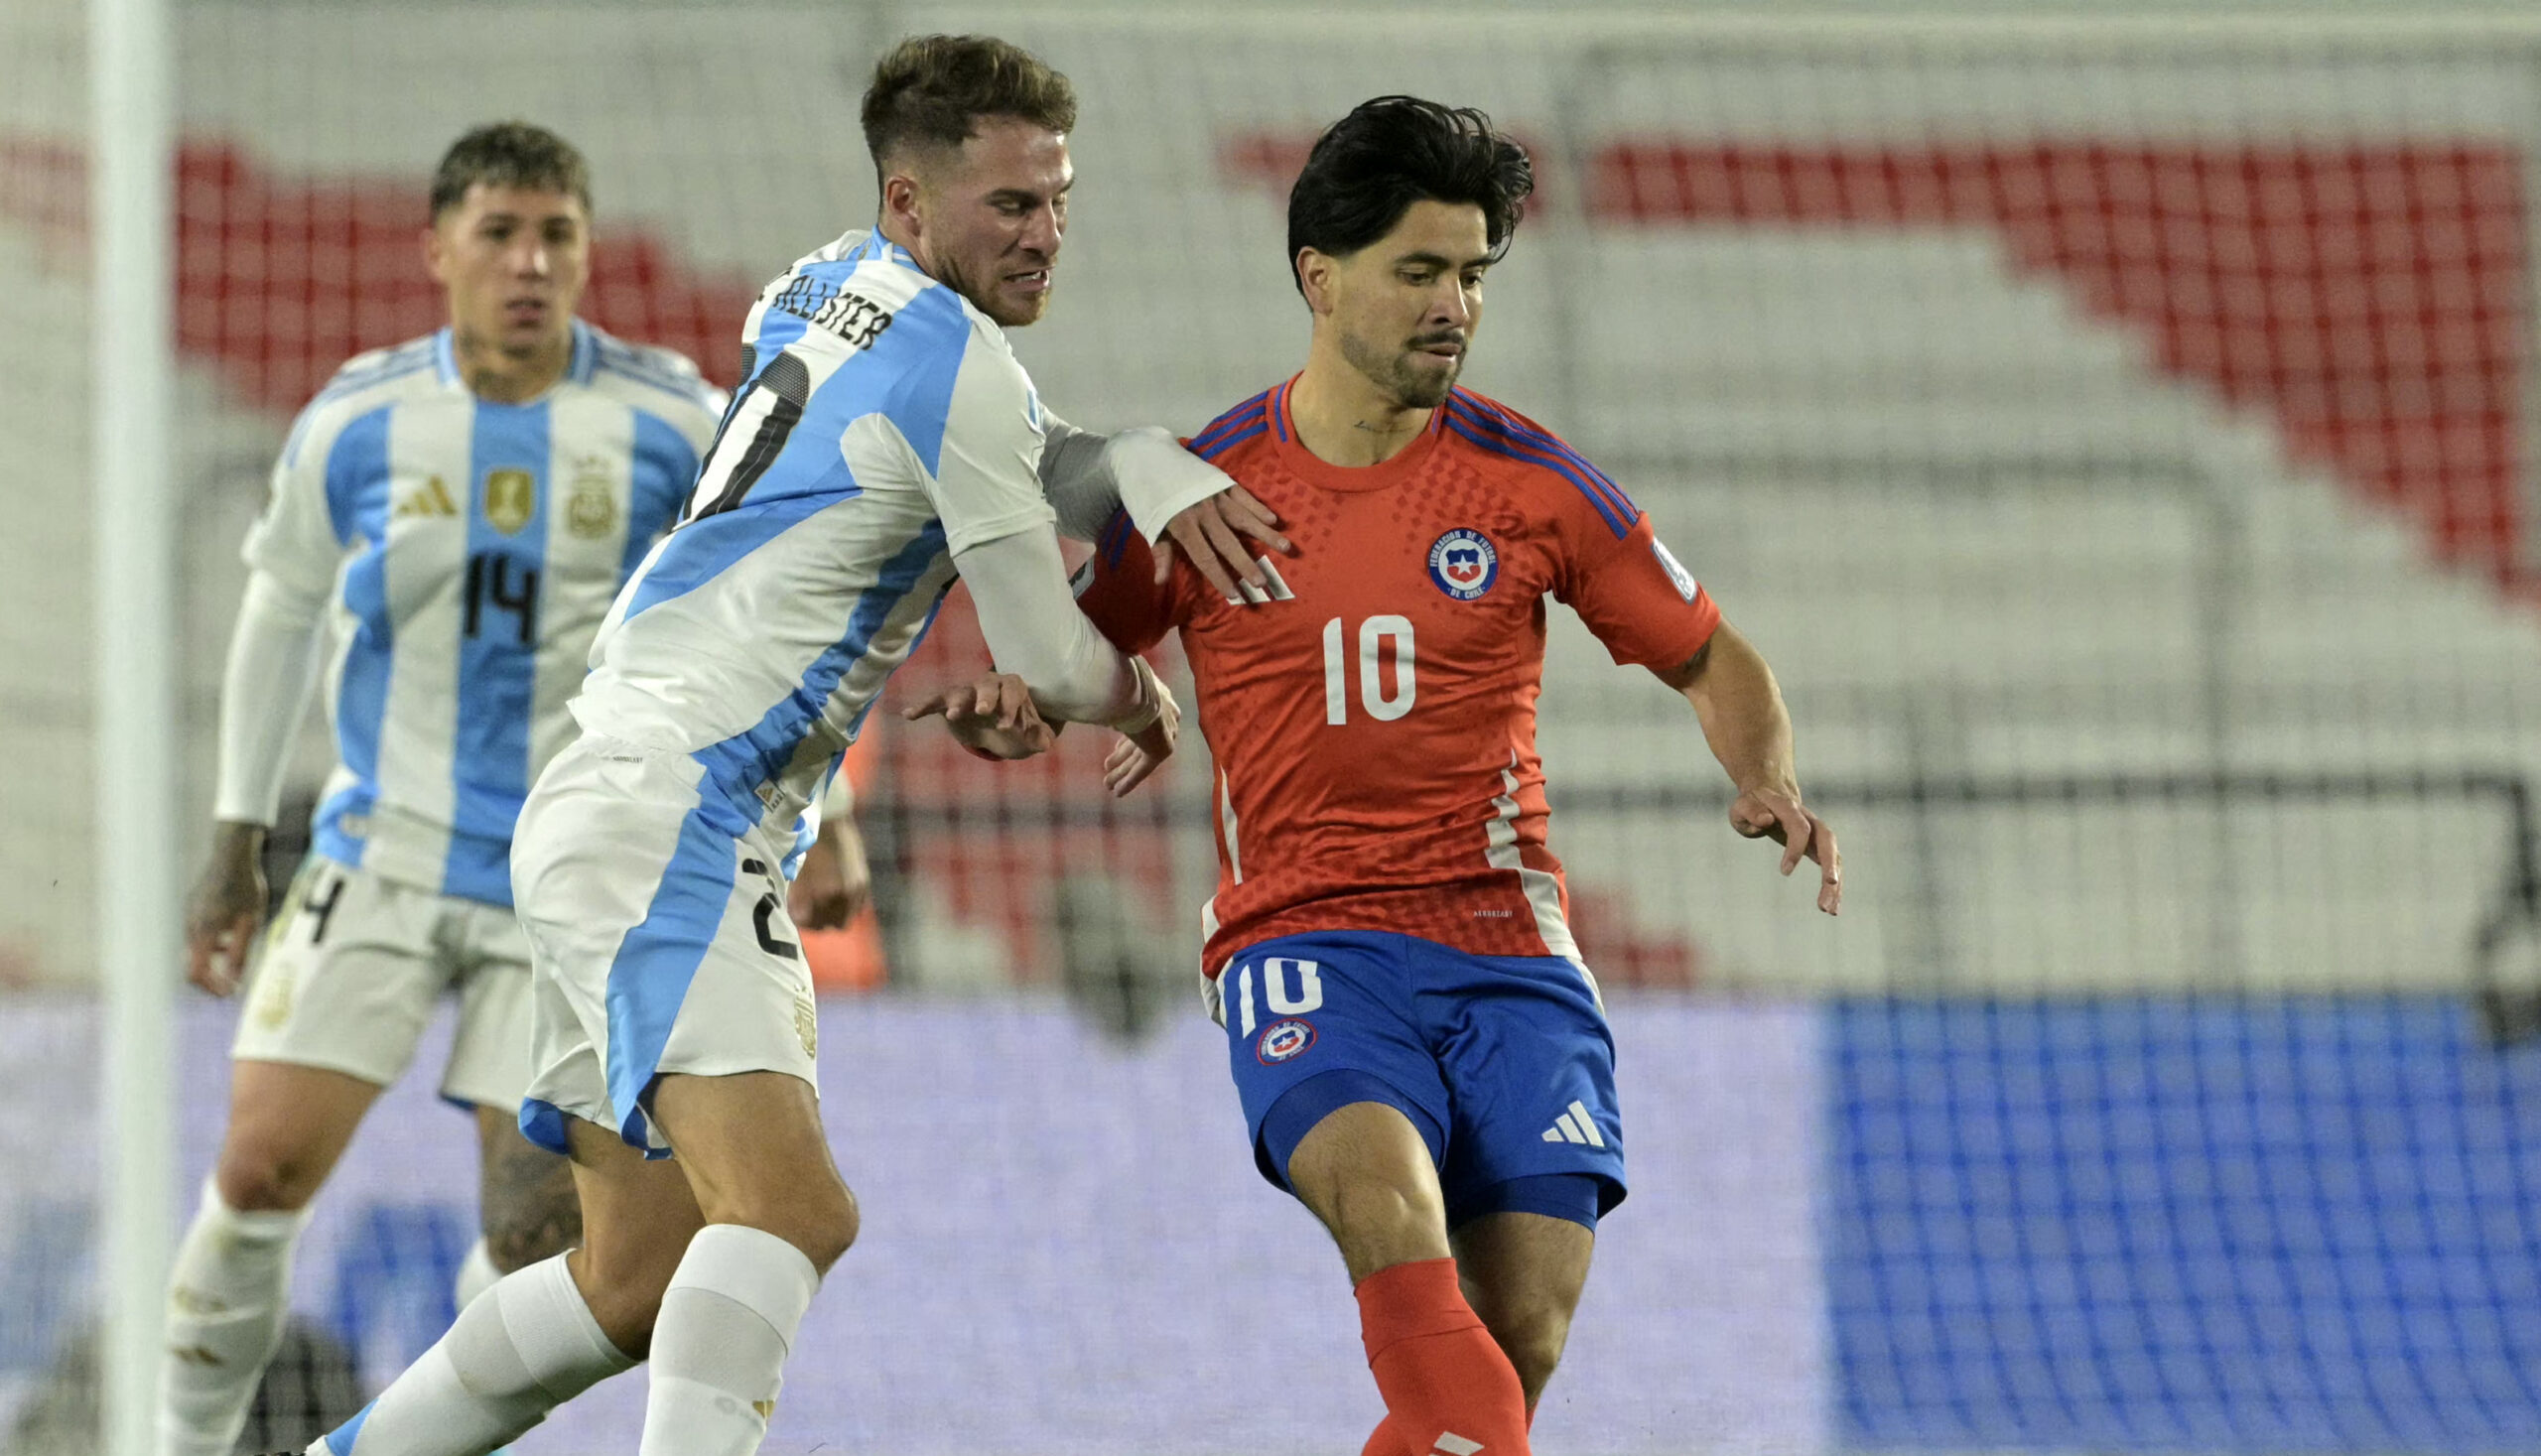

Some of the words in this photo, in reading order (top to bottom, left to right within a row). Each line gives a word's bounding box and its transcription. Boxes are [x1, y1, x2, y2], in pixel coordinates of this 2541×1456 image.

[1466, 531, 1477, 541] DE
[465, 552, 539, 644] 14
[1464, 587, 1485, 599] CHILE
[1323, 614, 1415, 726] 10
[1239, 957, 1323, 1039] 10
